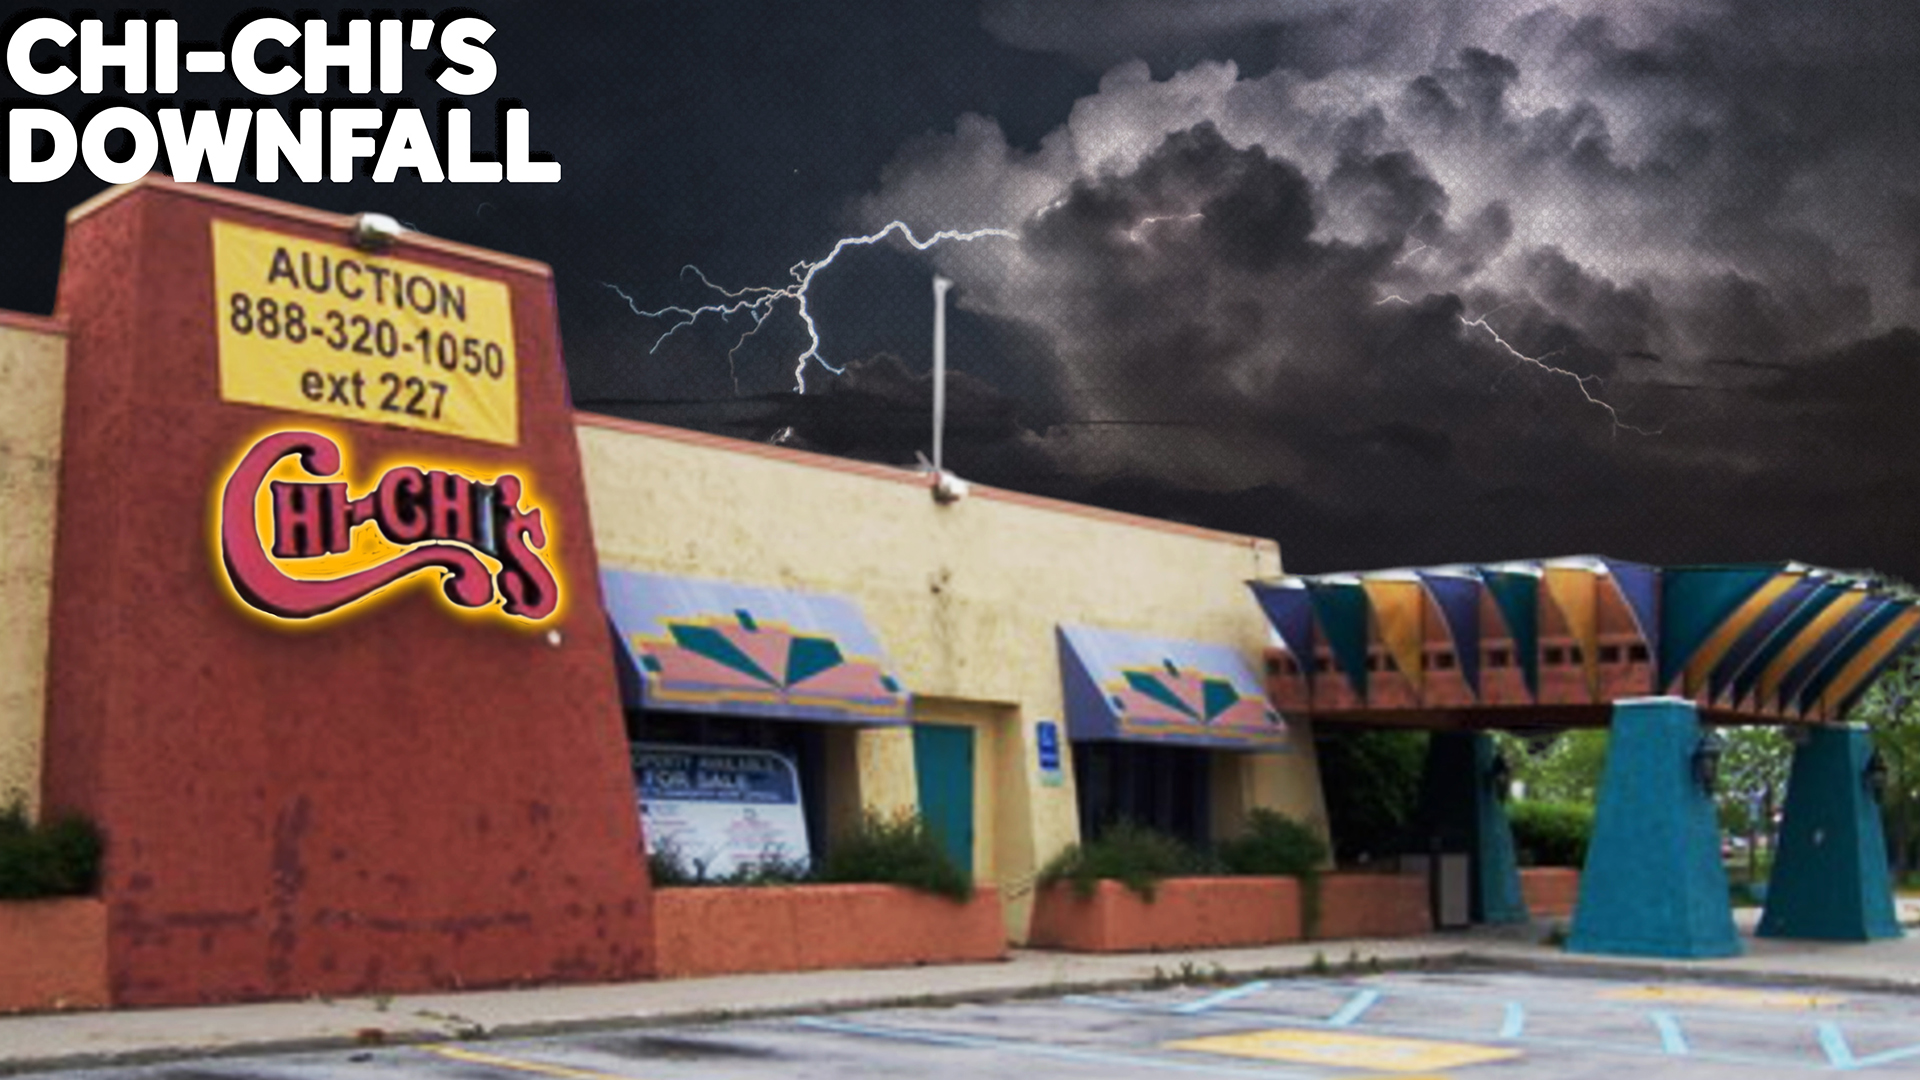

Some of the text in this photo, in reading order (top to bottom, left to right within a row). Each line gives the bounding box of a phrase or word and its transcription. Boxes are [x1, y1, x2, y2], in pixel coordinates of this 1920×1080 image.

[268, 247, 467, 322] AUCTION
[230, 292, 504, 379] 888-320-1050
[301, 369, 449, 420] ext 227
[643, 770, 749, 789] FOR SALE
